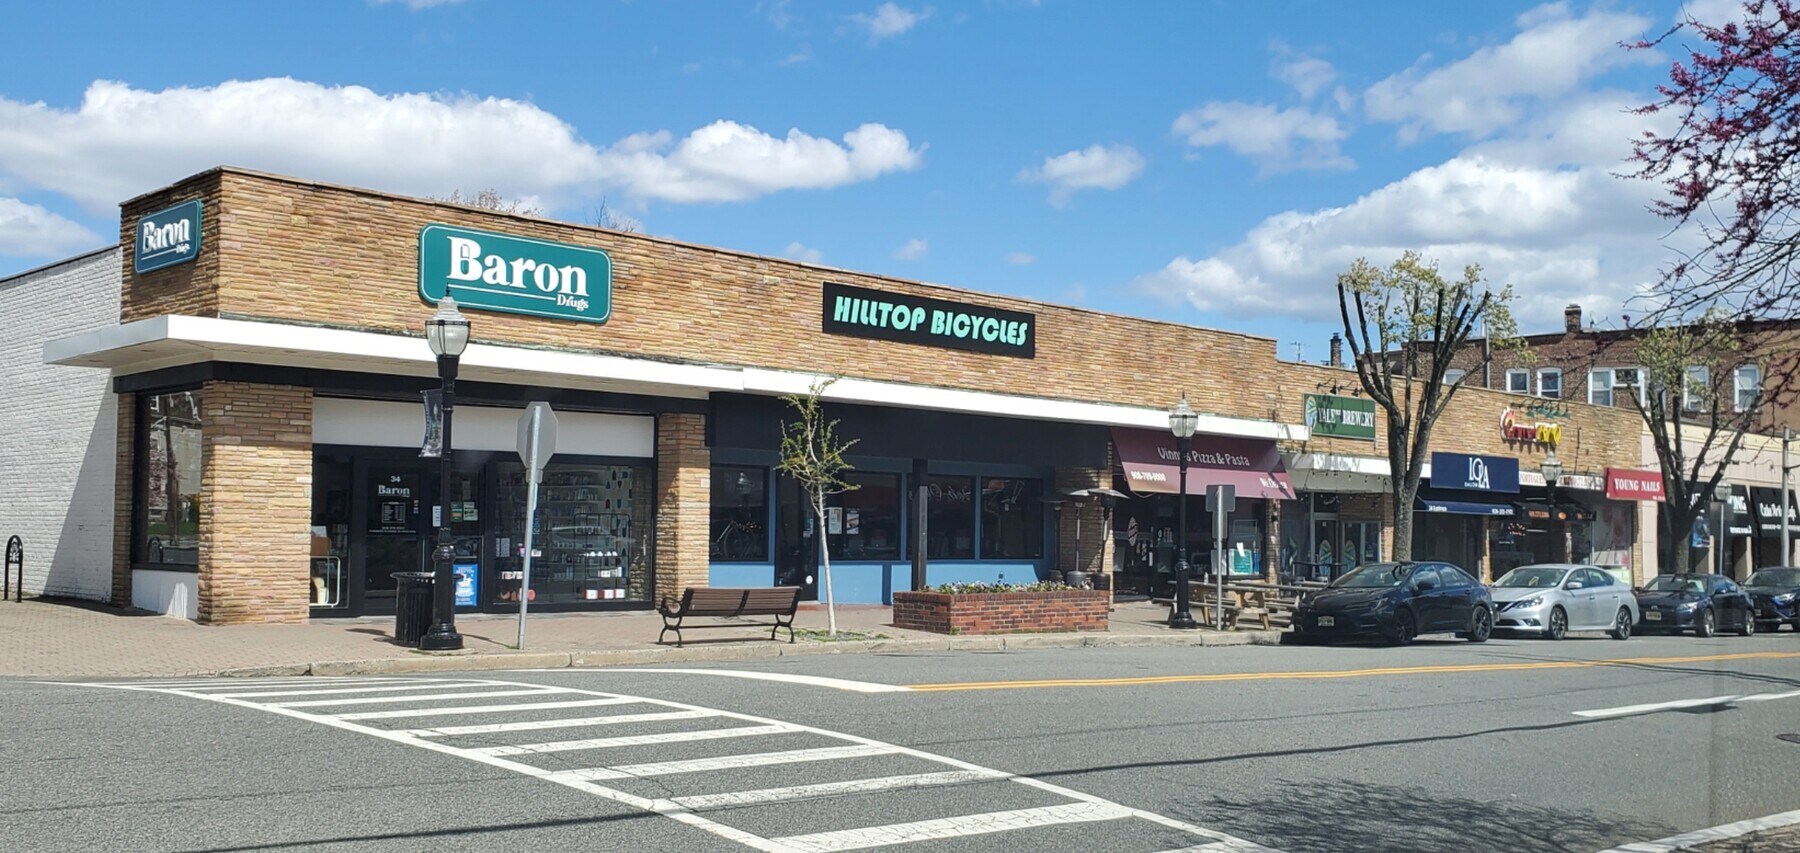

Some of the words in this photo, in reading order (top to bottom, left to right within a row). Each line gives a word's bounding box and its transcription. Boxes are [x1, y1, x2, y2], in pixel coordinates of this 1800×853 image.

[141, 219, 190, 254] Baron
[446, 236, 589, 296] Baron
[556, 294, 589, 311] Drugs
[833, 295, 926, 332] HILLTOP
[930, 309, 1028, 346] BICYCLES
[1342, 409, 1374, 428] BREWERY
[1191, 450, 1216, 464] Pizza
[1216, 452, 1225, 464] &
[1225, 453, 1250, 466] Pasta
[390, 475, 401, 483] 34
[1469, 457, 1490, 489] LOLA
[378, 484, 410, 495] Baron
[1614, 478, 1639, 491] YOUNG
[1641, 480, 1660, 492] NAILS
